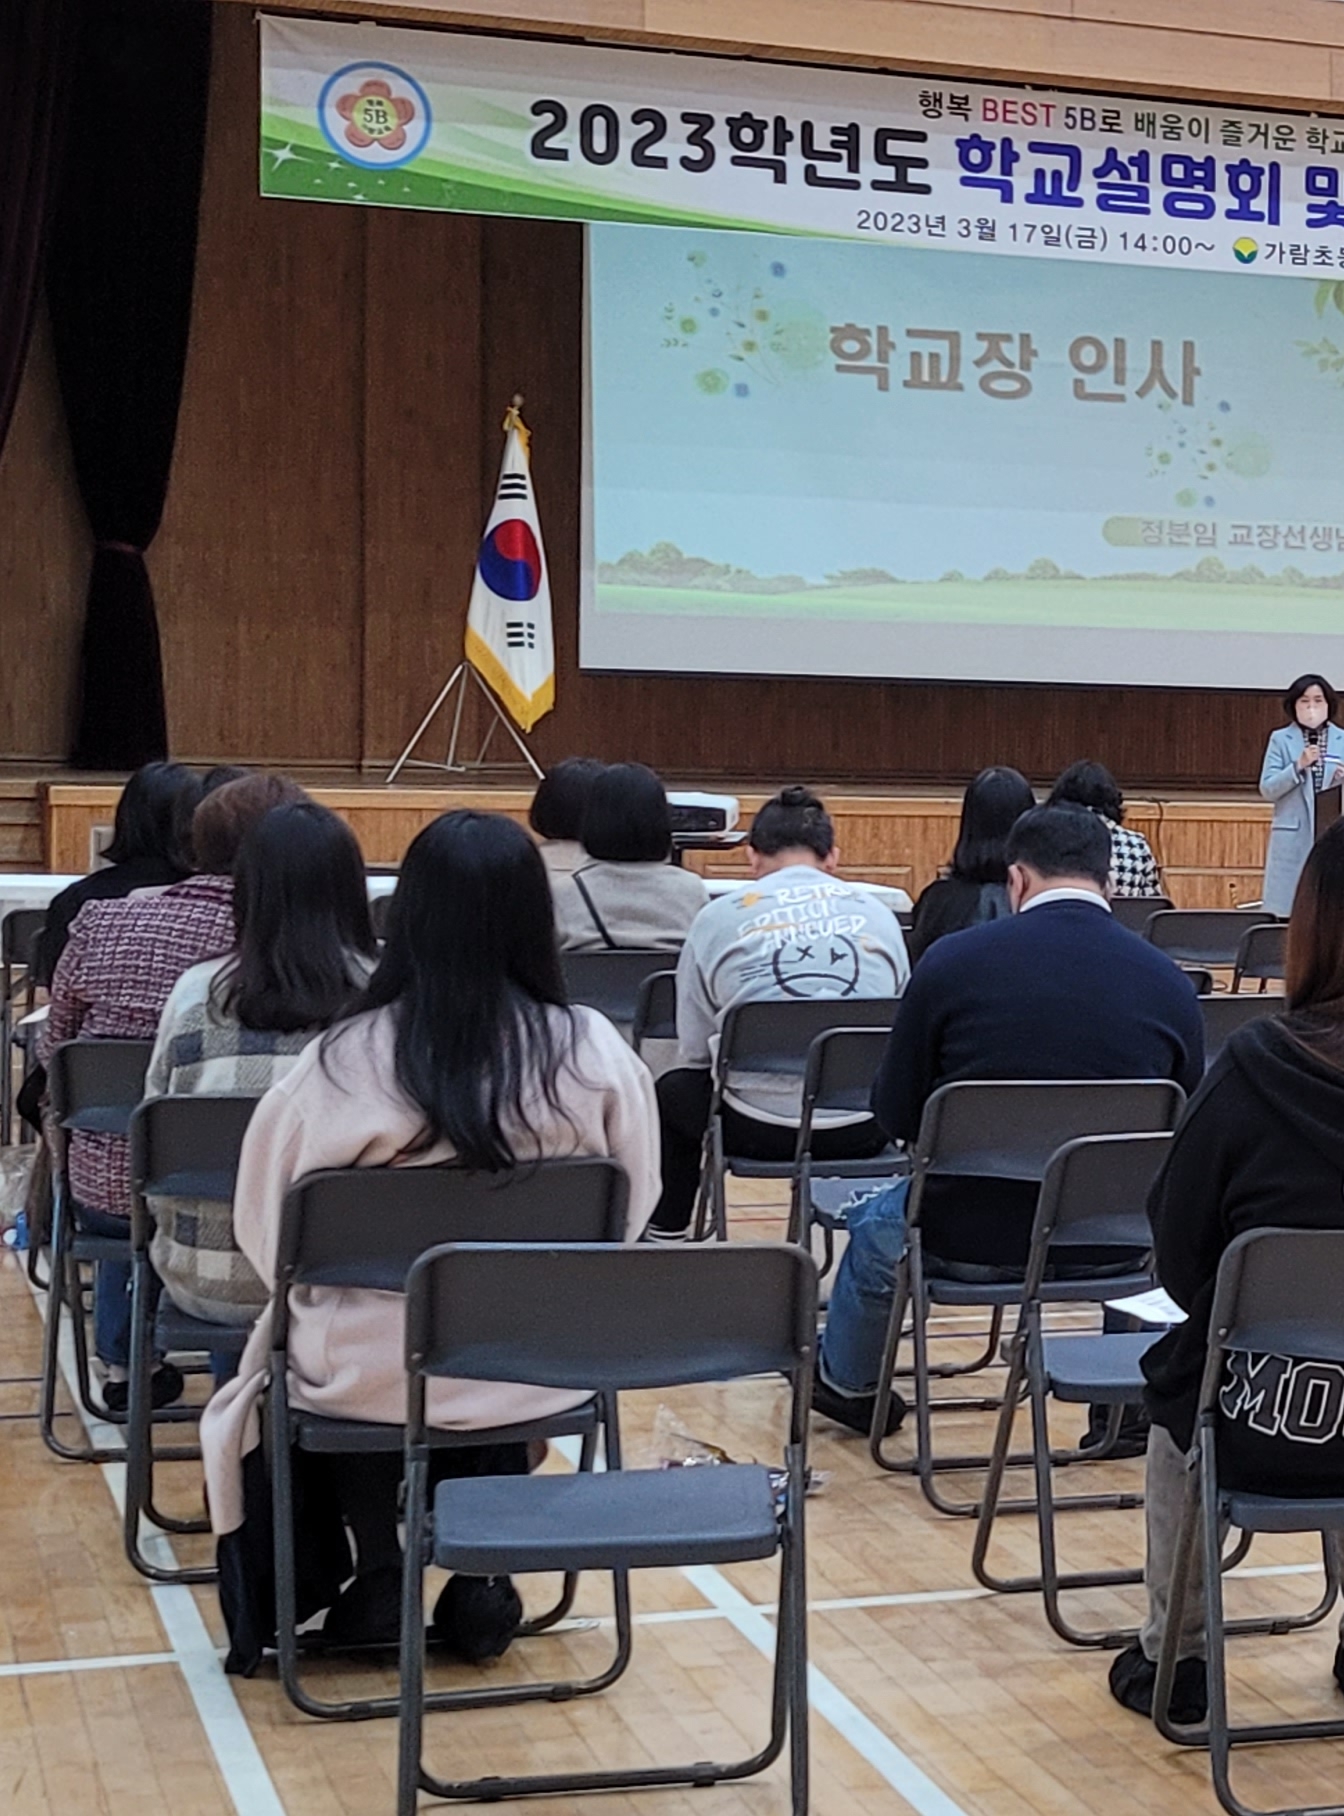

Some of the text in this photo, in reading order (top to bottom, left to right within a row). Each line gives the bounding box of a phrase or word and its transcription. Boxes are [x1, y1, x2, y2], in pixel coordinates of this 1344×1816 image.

[362, 107, 389, 124] 5B
[918, 90, 973, 122] 행복
[981, 98, 1056, 128] BEST
[1063, 105, 1124, 134] 5B로
[1133, 111, 1211, 145] 배움이
[1219, 120, 1298, 152] 즐거운
[529, 99, 932, 195] 2023학년도
[955, 133, 1281, 226] 학교설명회
[856, 209, 948, 239] 2023년
[956, 216, 998, 243] 3월
[1008, 222, 1108, 252] 17일(금)
[827, 322, 1204, 406] 학교장 인사
[1141, 520, 1217, 548] 정분임
